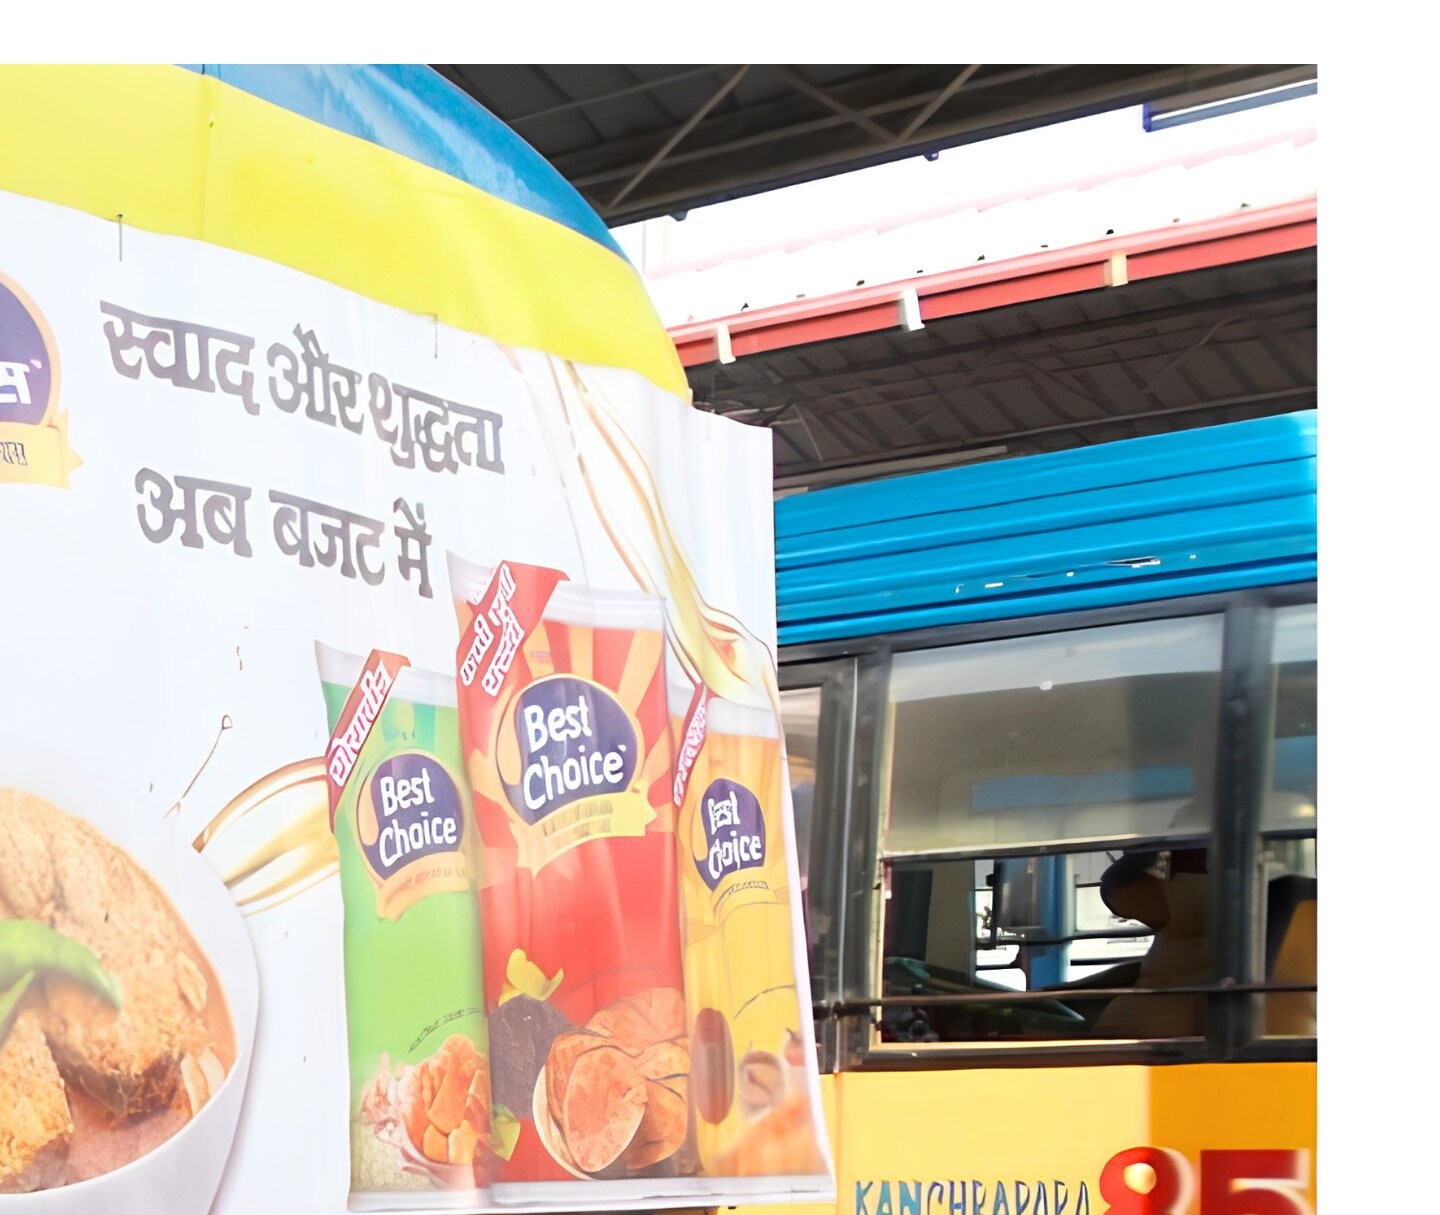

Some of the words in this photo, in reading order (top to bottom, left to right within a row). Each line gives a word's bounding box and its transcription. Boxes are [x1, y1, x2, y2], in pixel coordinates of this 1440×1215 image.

[100, 300, 260, 416] स्वाद
[267, 323, 364, 435] और
[368, 372, 505, 475] शुद्धता
[135, 467, 253, 558] अब
[269, 489, 385, 586] बजट
[393, 497, 433, 600] में
[523, 695, 592, 752] Best
[380, 768, 435, 817] Best
[522, 749, 622, 811] Choice
[379, 815, 457, 867] Choice
